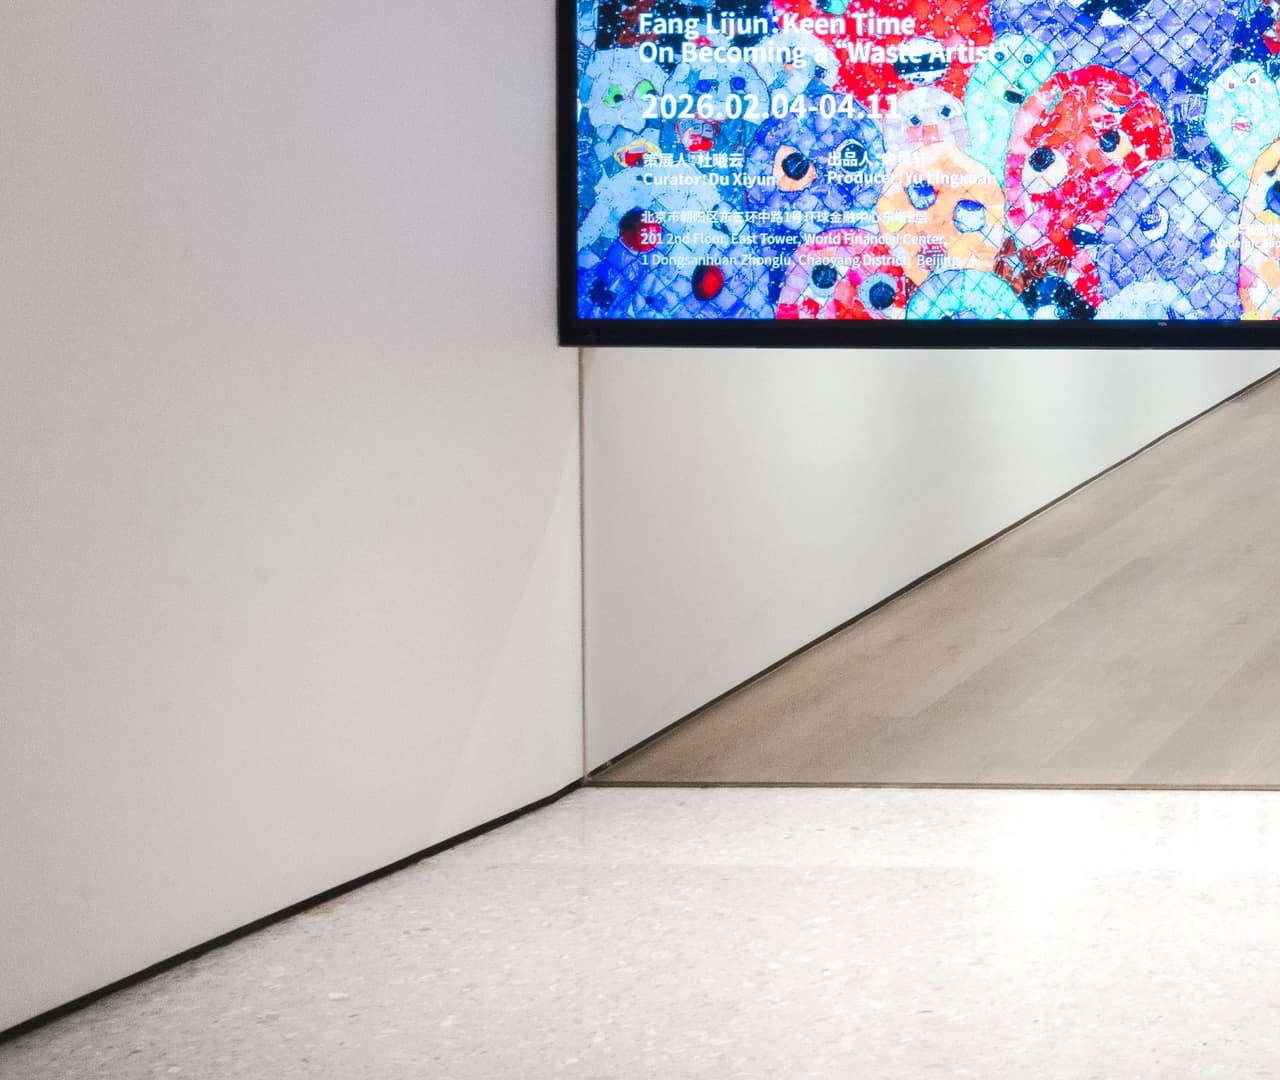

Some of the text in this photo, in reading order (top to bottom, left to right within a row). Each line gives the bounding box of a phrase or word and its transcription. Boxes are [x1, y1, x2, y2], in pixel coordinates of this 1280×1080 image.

[639, 14, 700, 39] Fang
[852, 13, 916, 35] Time
[639, 43, 674, 64] On
[682, 42, 803, 69] Becoming
[813, 46, 829, 64] a
[641, 94, 900, 120] 2026.02.04-04.11
[732, 172, 777, 188] Xiyun
[641, 233, 663, 245] 201
[667, 232, 690, 245] 2nd
[732, 233, 757, 245] East
[761, 233, 801, 247] Tower,
[804, 232, 841, 245] World
[844, 232, 900, 245] Financial
[642, 254, 648, 266] 1
[798, 254, 861, 269] Chaoyang
